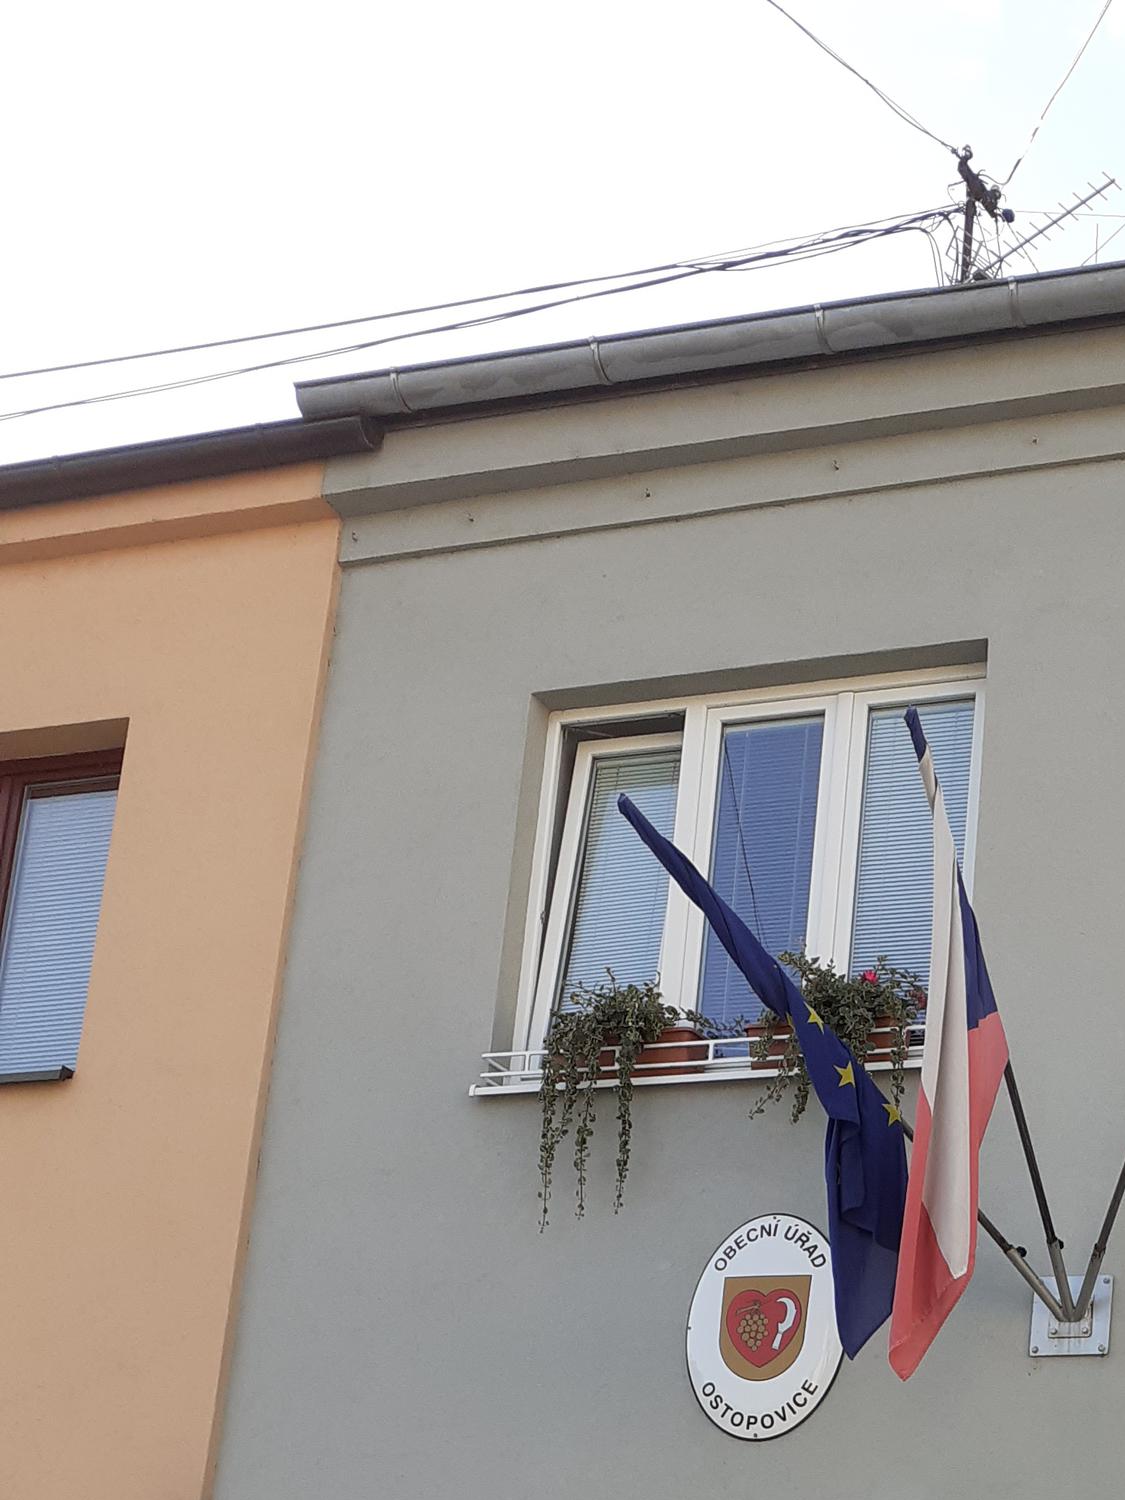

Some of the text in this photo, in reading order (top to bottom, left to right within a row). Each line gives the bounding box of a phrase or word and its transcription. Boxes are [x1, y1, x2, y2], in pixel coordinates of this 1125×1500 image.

[714, 1219, 827, 1271] OBECNÍ ÚŘAD
[702, 1379, 818, 1431] OSTOPOVICE
